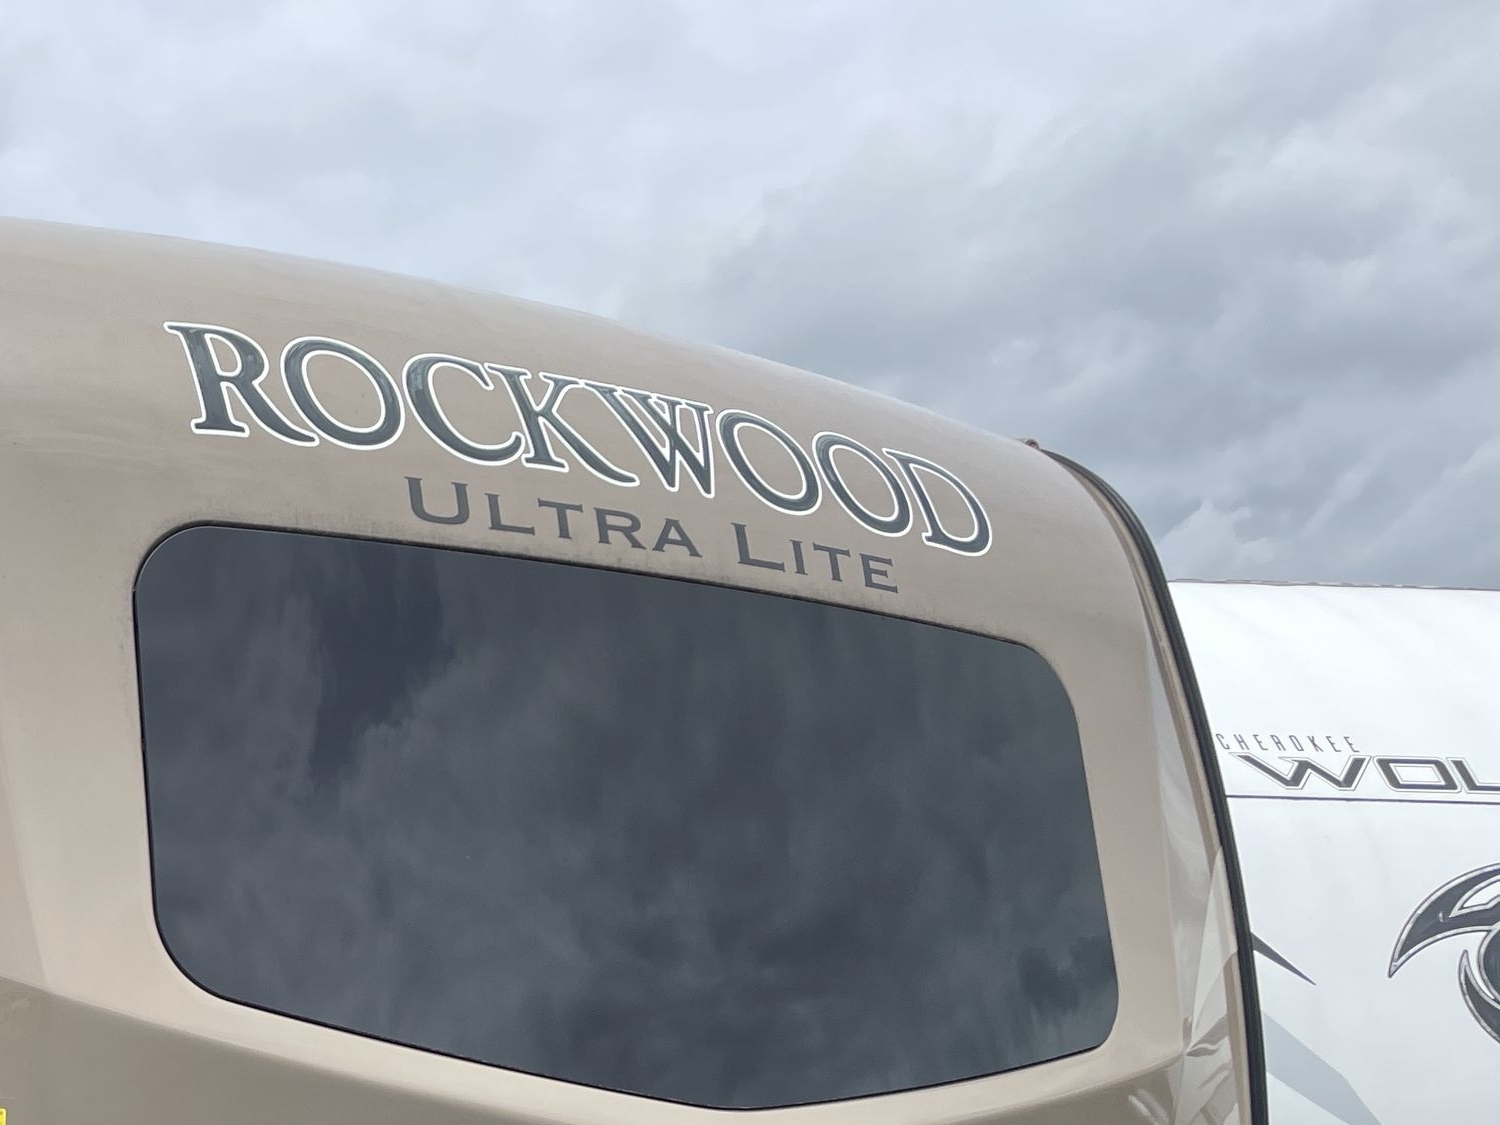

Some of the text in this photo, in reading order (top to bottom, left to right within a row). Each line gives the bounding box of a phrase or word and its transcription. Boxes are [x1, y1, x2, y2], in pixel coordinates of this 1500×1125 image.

[163, 320, 993, 557] ROCKWOOD
[403, 474, 900, 595] ULTRA LITE
[1215, 733, 1361, 753] CHEROKEE
